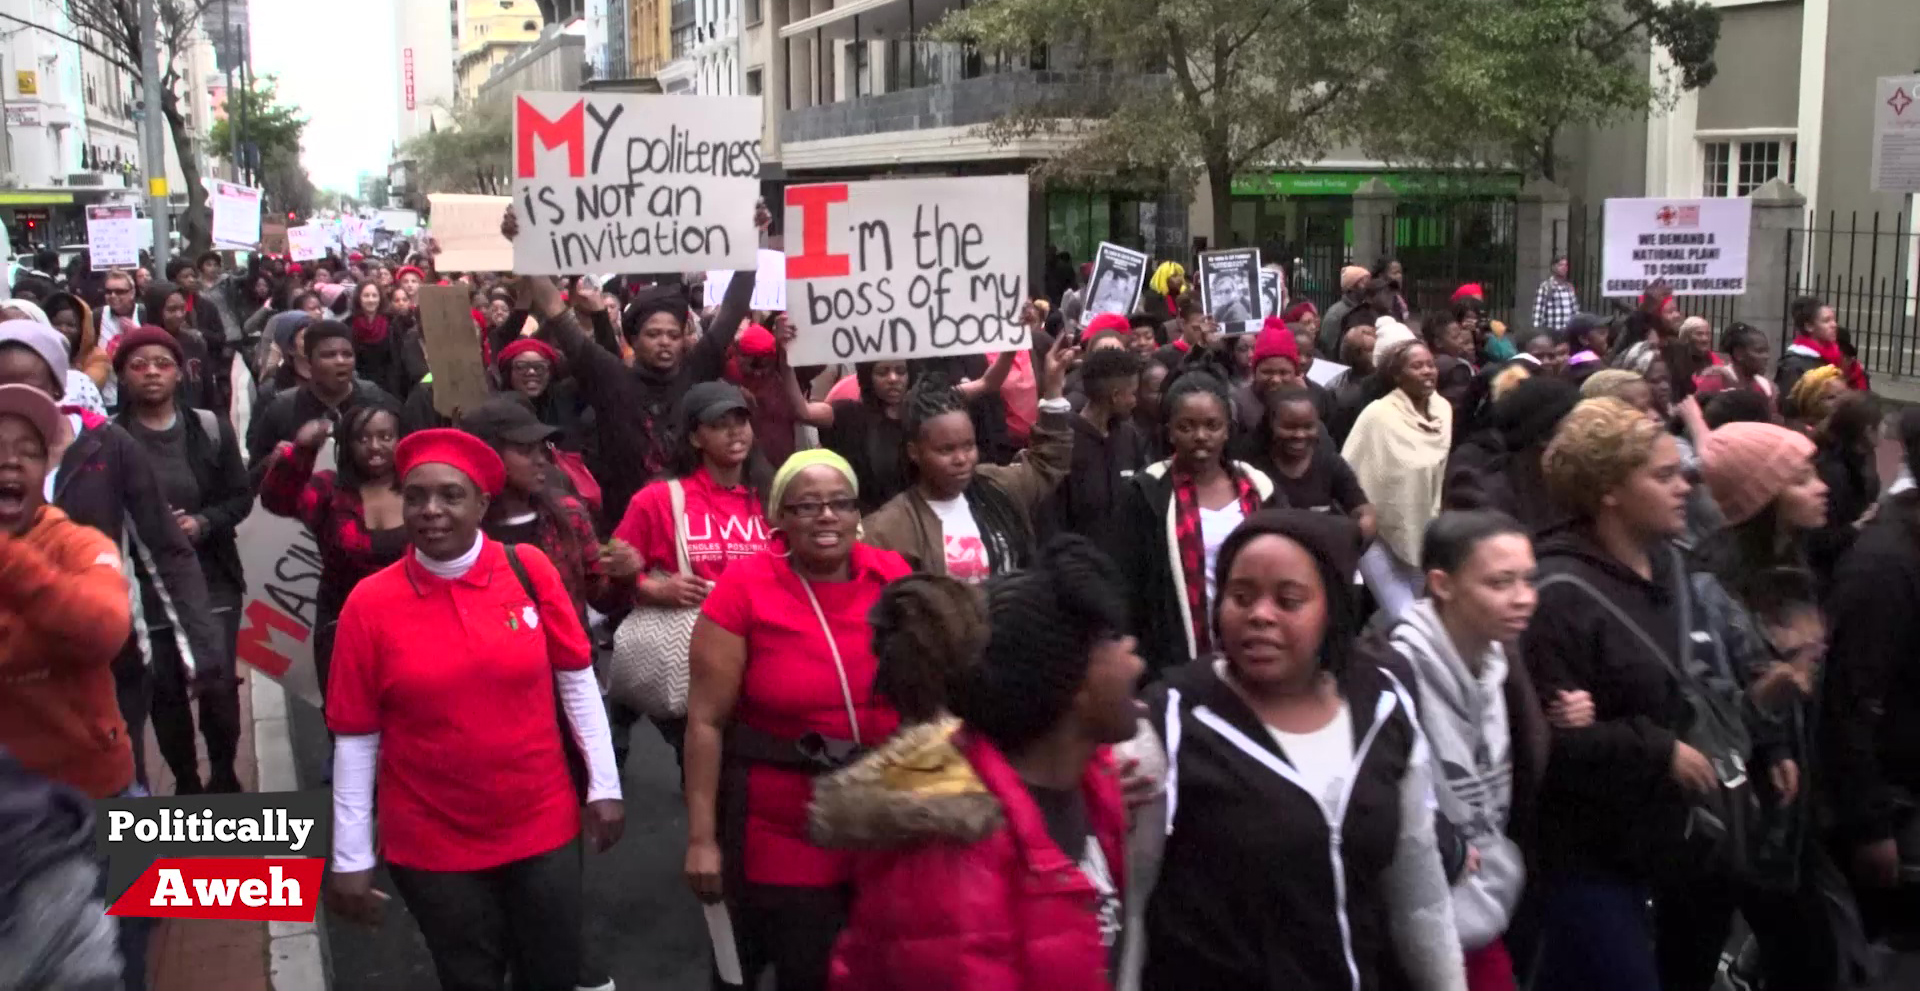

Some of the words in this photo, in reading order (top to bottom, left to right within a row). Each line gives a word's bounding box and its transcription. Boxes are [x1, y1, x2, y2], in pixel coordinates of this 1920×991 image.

[516, 96, 624, 179] MY
[626, 123, 762, 180] politeness
[575, 181, 644, 218] NOT
[647, 184, 702, 217] an
[549, 220, 731, 270] invitation
[913, 204, 990, 270] the
[1632, 248, 1685, 261] NATIONAL
[1638, 233, 1656, 245] WE
[1658, 232, 1705, 245] DEMAND
[1707, 232, 1715, 244] A
[1643, 263, 1657, 275] TO
[1660, 263, 1707, 275] COMBAT
[1691, 277, 1743, 290] VIOLENCE
[806, 276, 894, 326] boss
[907, 267, 950, 309] of
[971, 272, 1022, 319] my
[832, 319, 917, 358] own
[928, 305, 1026, 350] body
